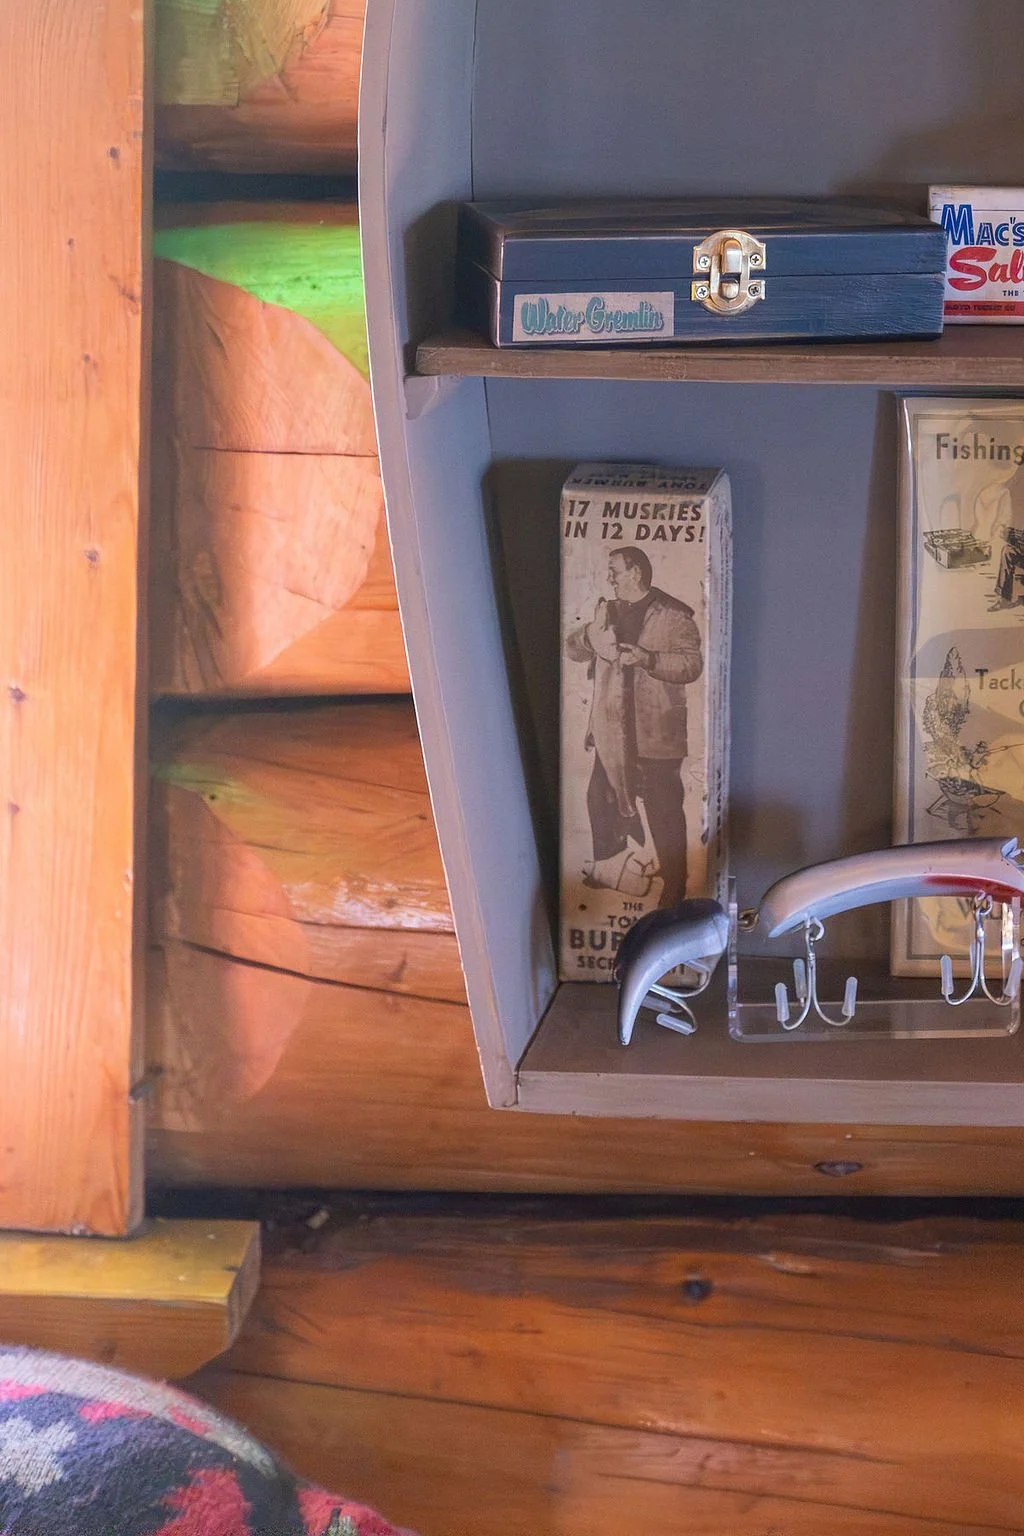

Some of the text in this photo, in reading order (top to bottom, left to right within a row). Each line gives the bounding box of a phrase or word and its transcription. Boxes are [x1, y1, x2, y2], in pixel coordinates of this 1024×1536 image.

[520, 296, 665, 334] Water Gremlin
[568, 500, 702, 522] 17 MUSKIES
[564, 522, 706, 543] IN 12 DAYS!
[623, 902, 644, 911] THE
